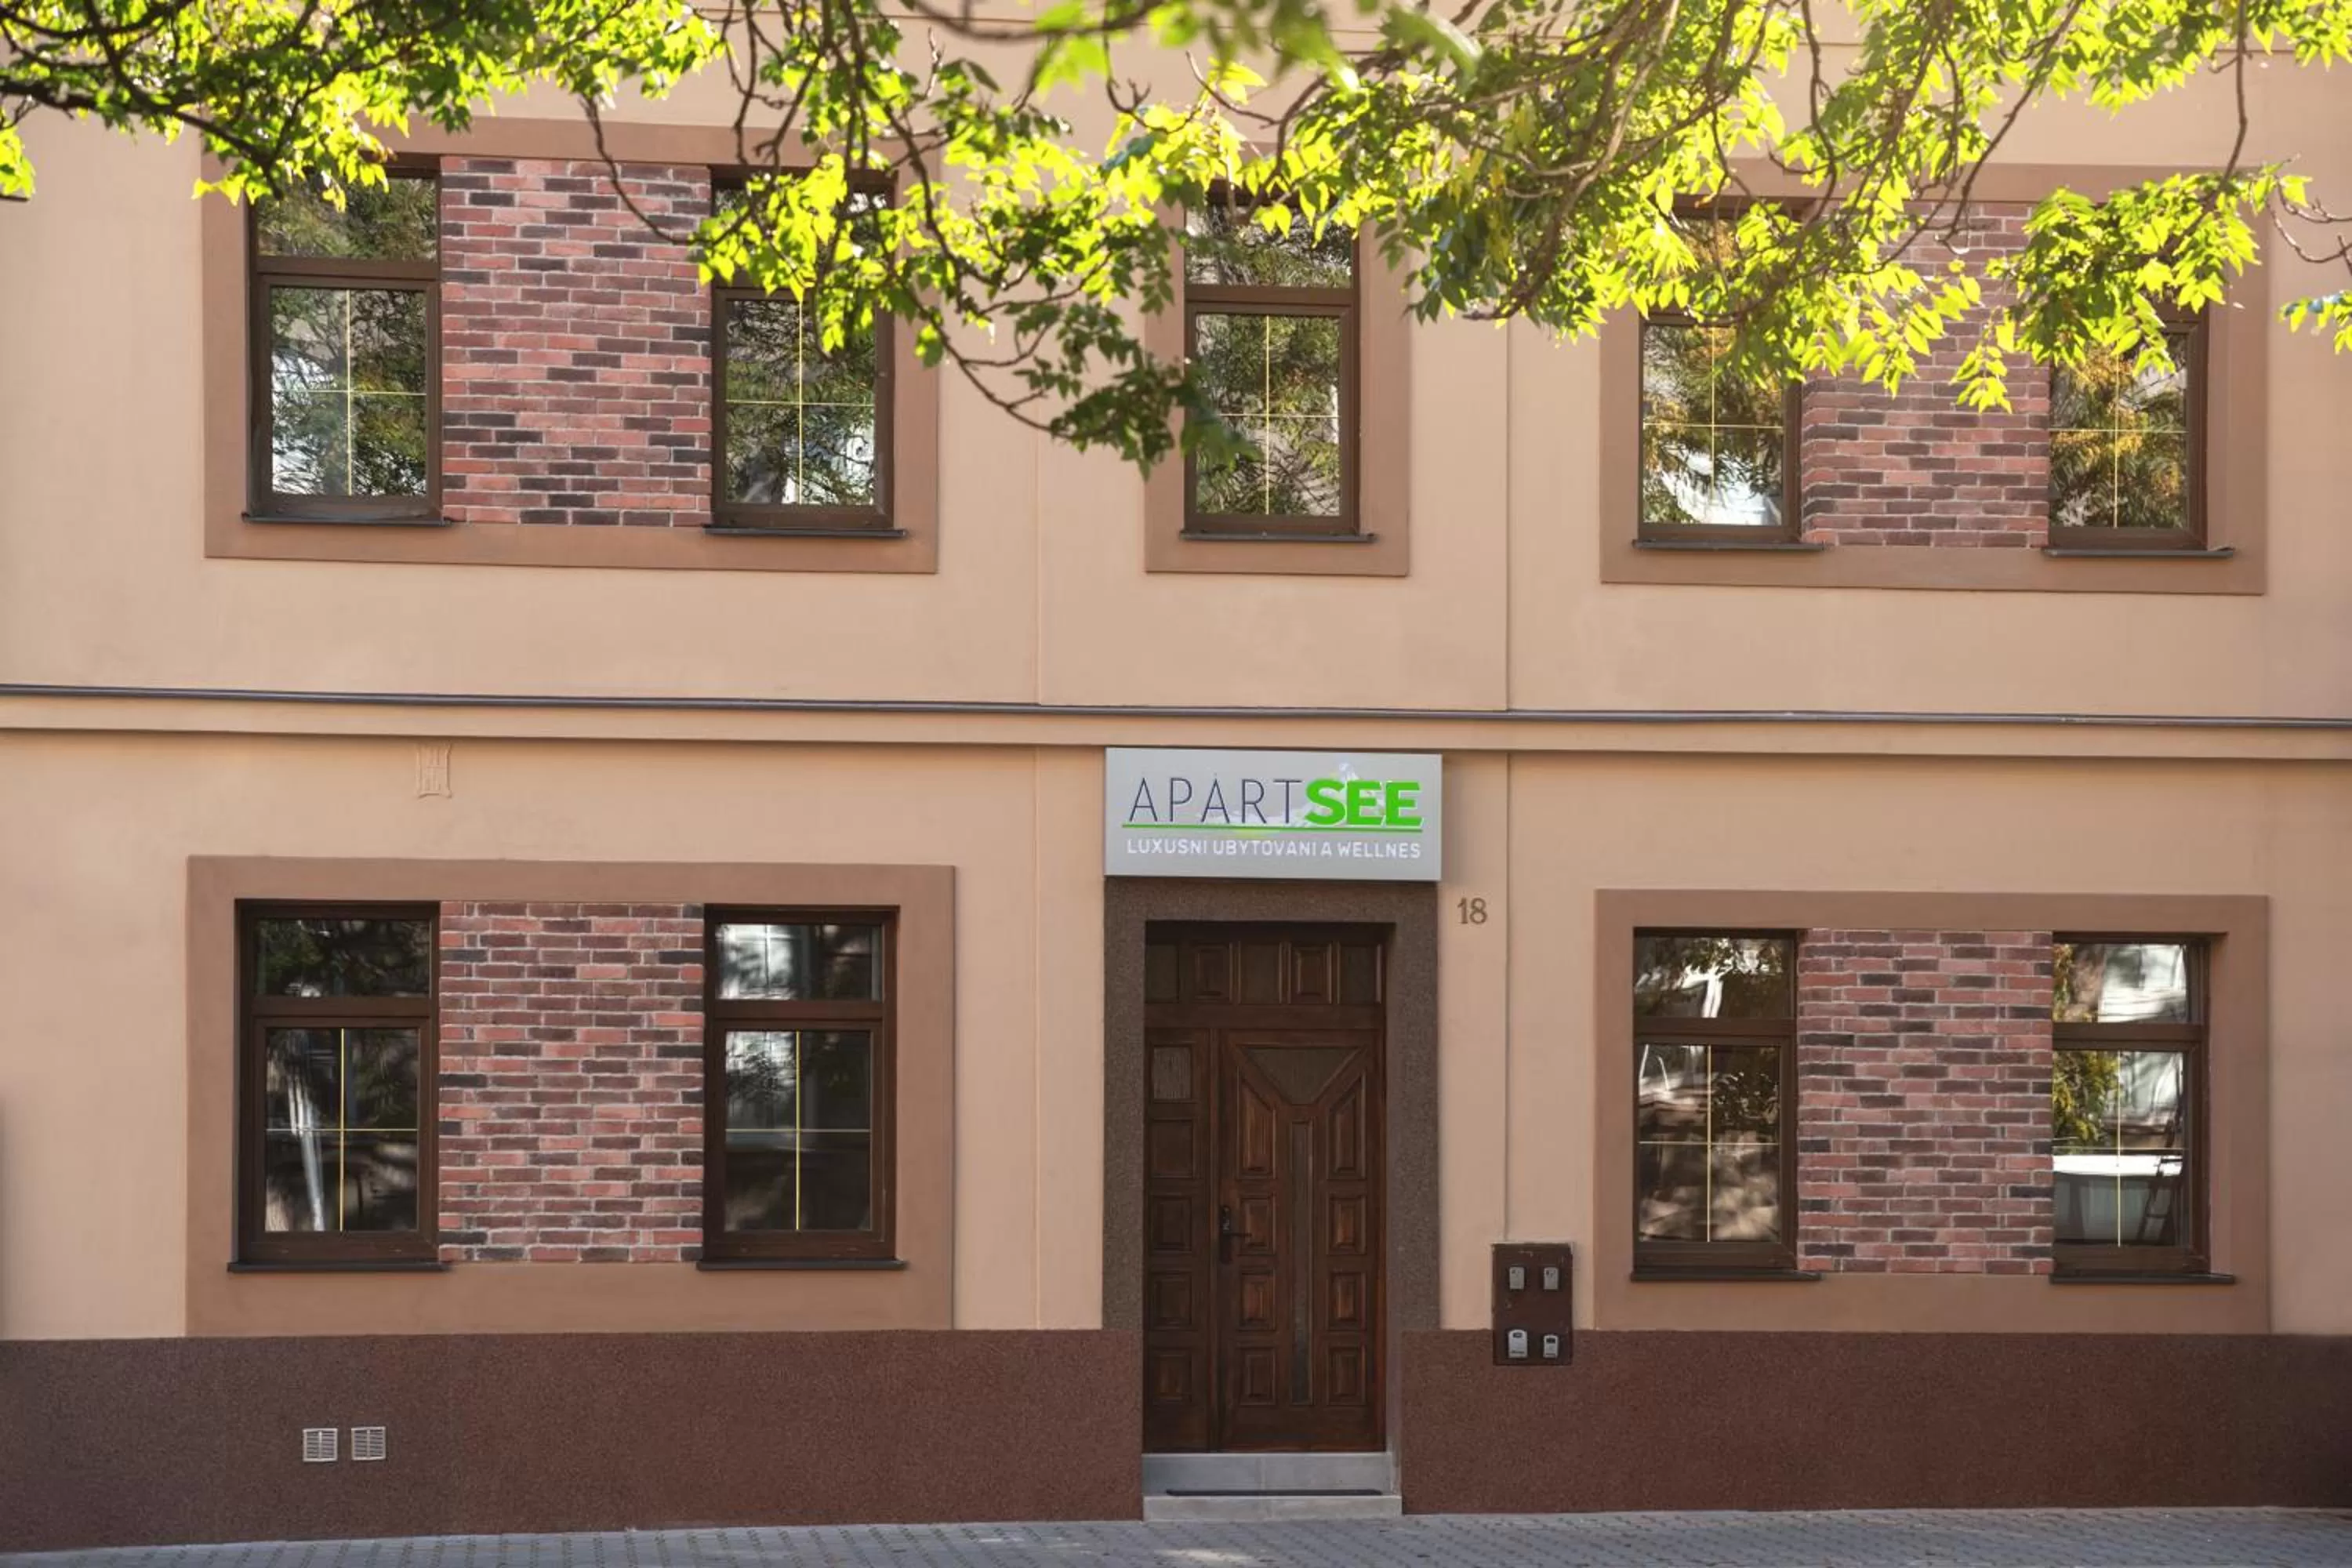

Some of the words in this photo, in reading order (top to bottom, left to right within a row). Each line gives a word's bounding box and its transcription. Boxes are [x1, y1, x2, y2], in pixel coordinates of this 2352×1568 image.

[1127, 839, 1207, 854] LUXUSNI
[1320, 841, 1333, 858] A
[1337, 842, 1421, 859] WELLNES
[1457, 897, 1488, 925] 18
